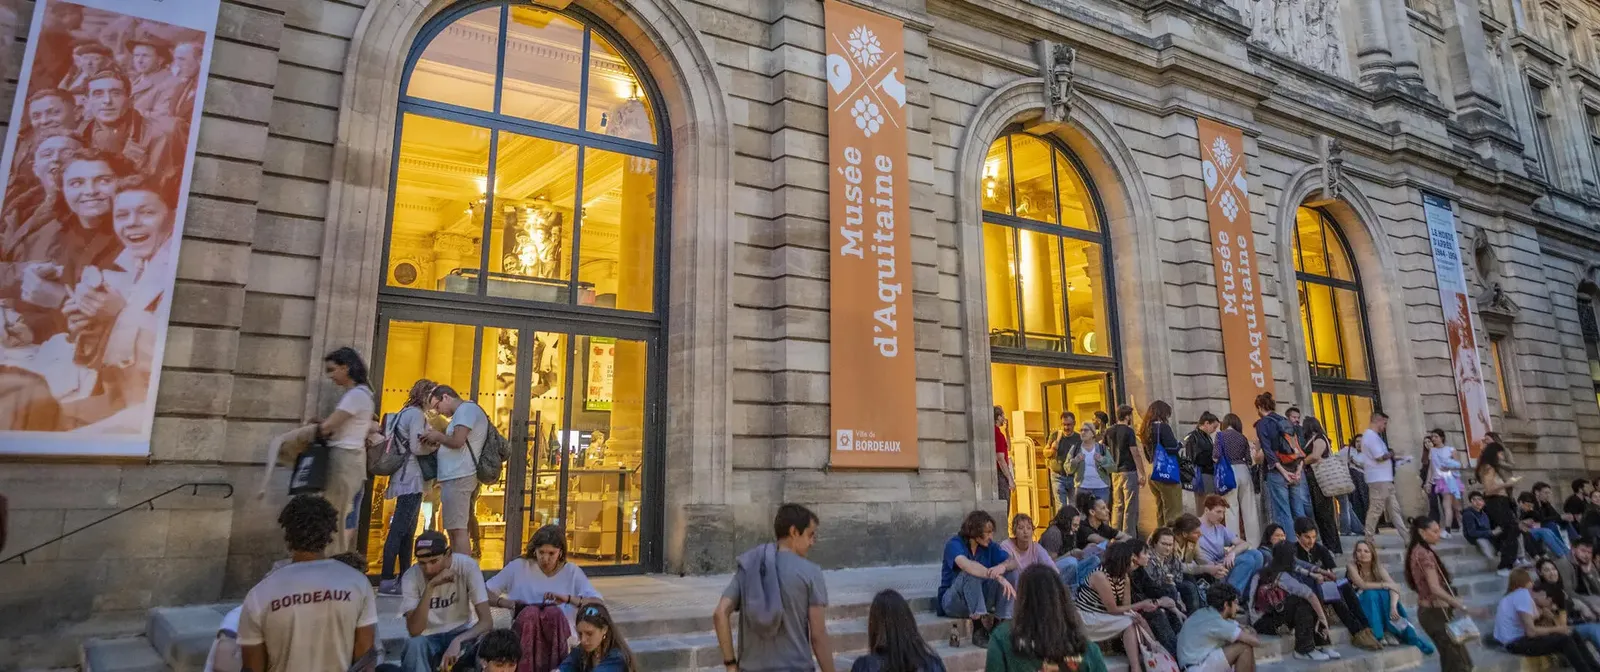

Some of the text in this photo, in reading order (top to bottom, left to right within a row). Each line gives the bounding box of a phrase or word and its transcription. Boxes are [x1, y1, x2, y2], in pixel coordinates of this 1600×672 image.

[837, 146, 864, 260] Musée
[1437, 230, 1454, 242] MONDE
[870, 155, 901, 358] d'Aquitaine
[1217, 231, 1238, 315] Musée
[1237, 236, 1264, 388] d'Aquitaine
[856, 440, 901, 452] BORDEAUX
[271, 589, 352, 612] BORDEAUX
